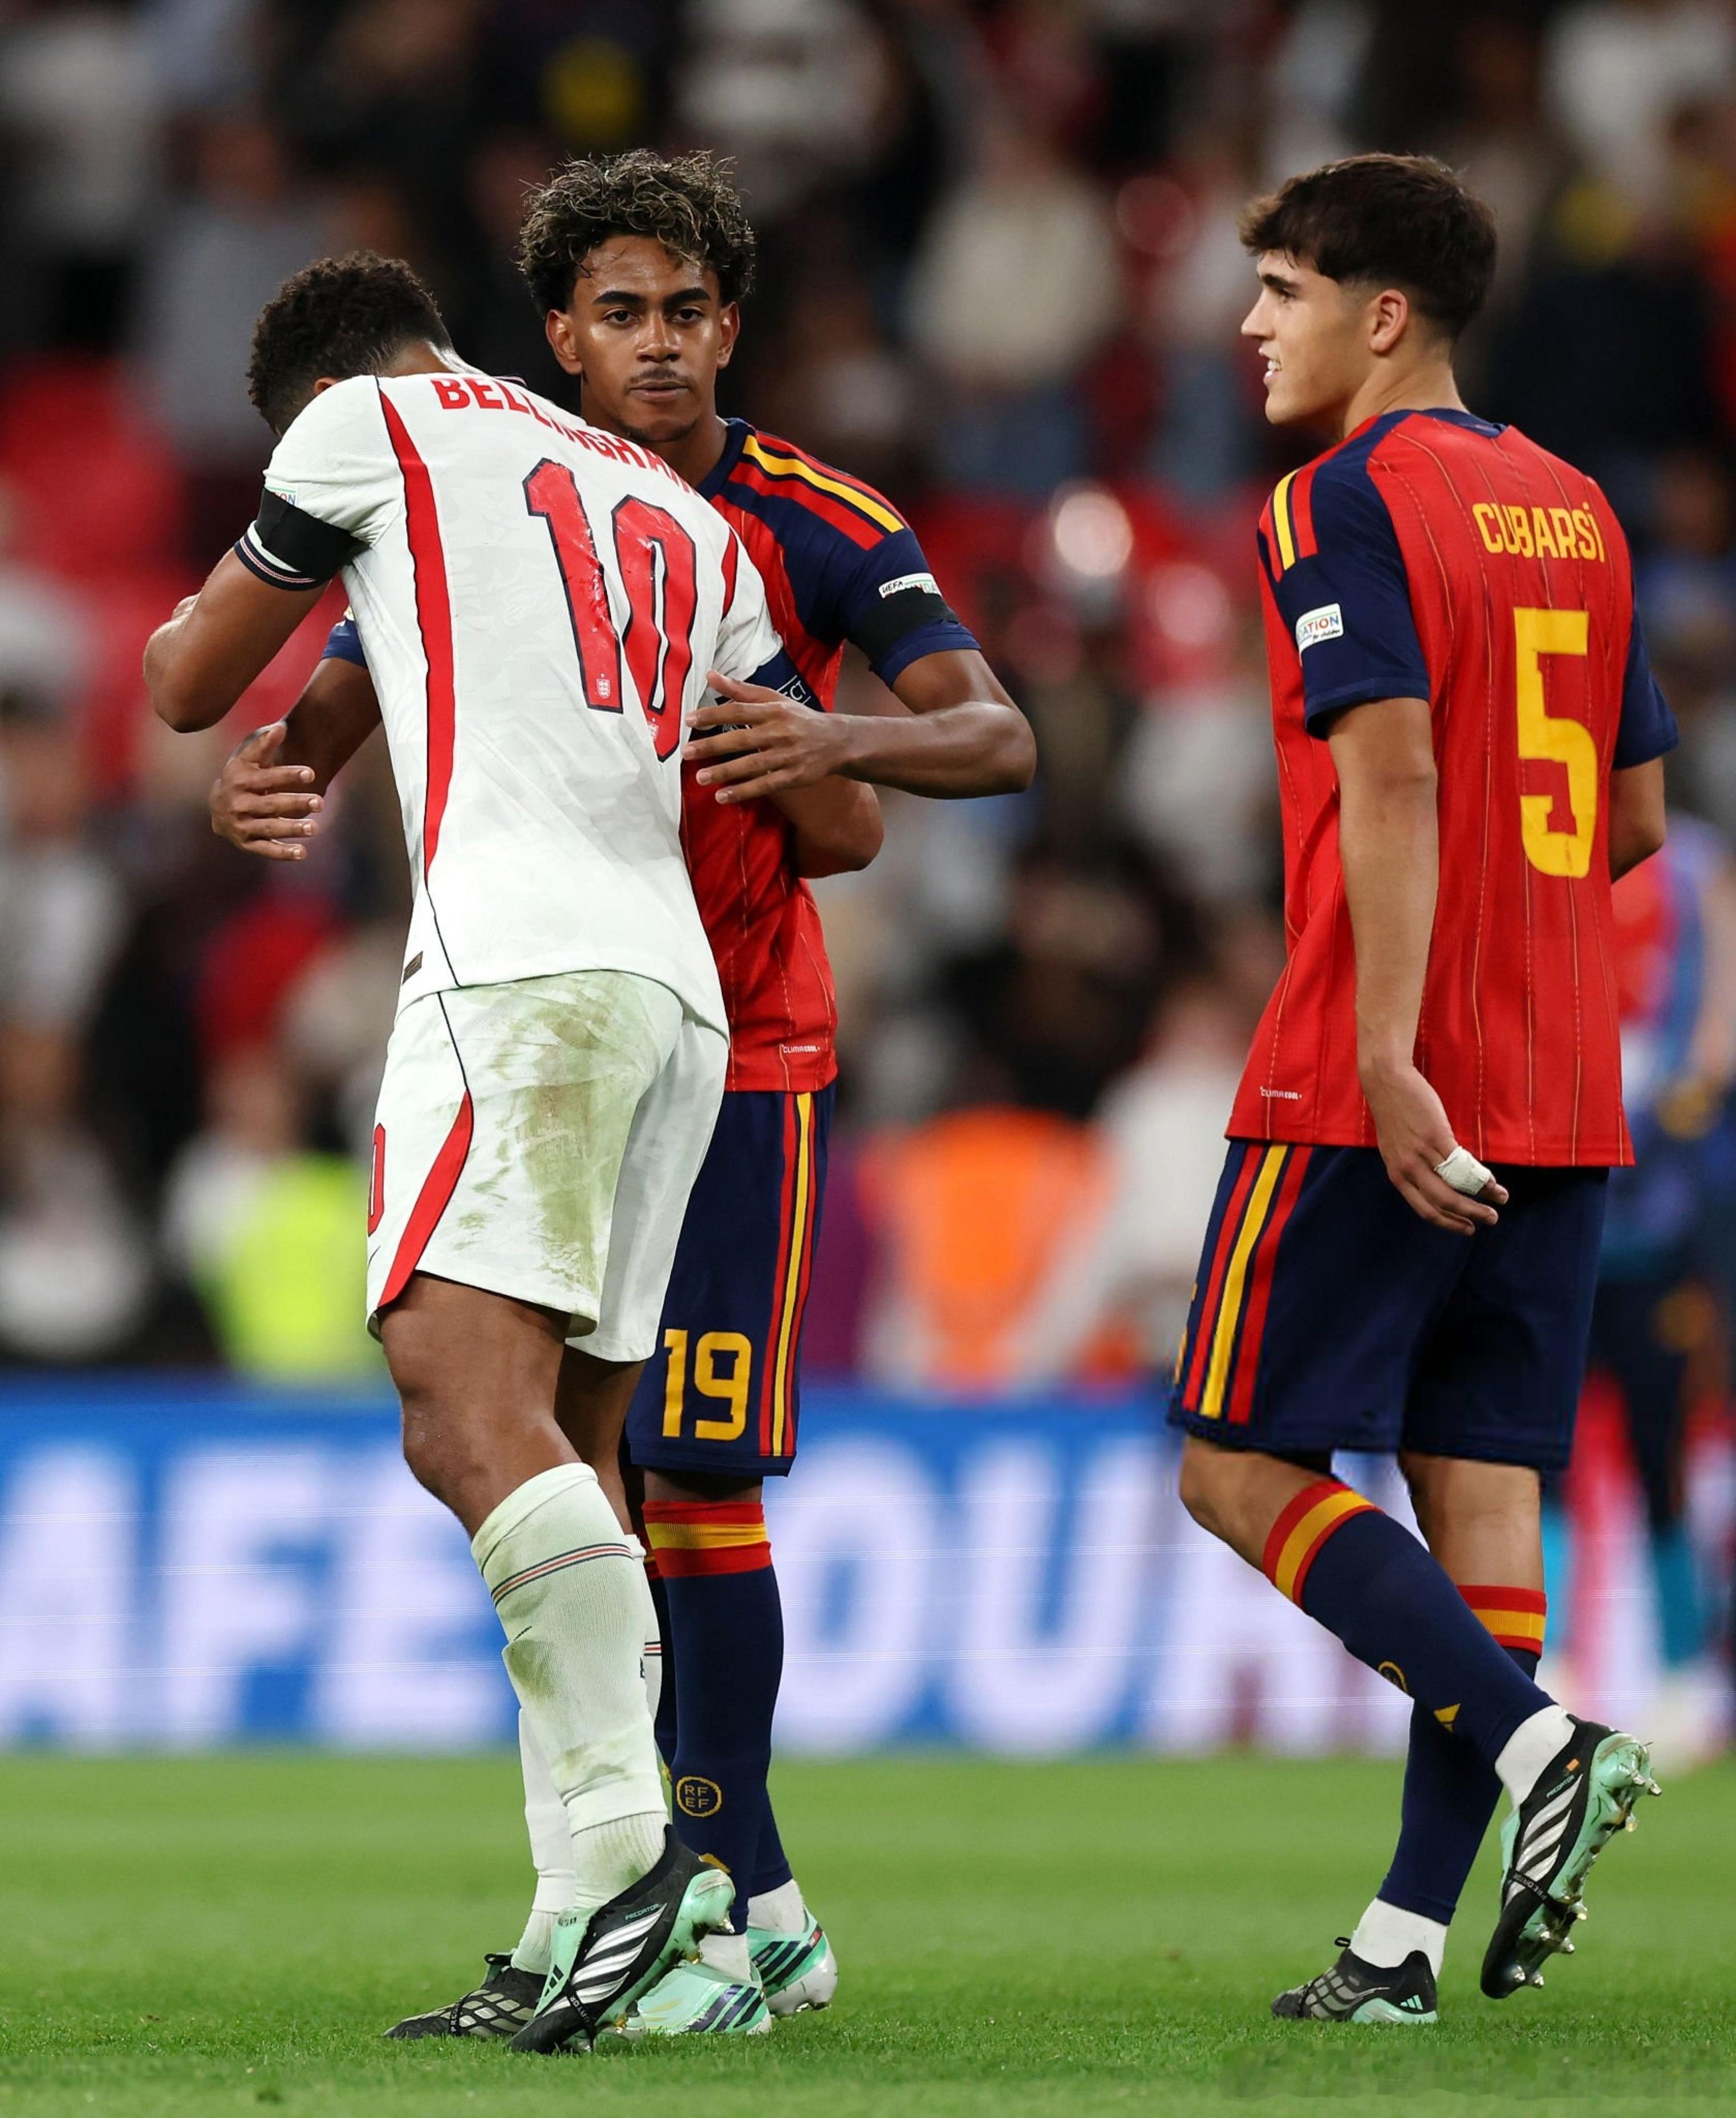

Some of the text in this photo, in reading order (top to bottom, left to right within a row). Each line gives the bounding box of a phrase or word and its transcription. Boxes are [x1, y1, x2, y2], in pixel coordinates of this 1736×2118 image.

[522, 457, 697, 763] 10
[882, 580, 903, 593] UEFA
[1513, 607, 1597, 878] 5
[663, 1329, 752, 1441] 19
[684, 1784, 708, 1797] RF
[685, 1796, 709, 1809] EF
